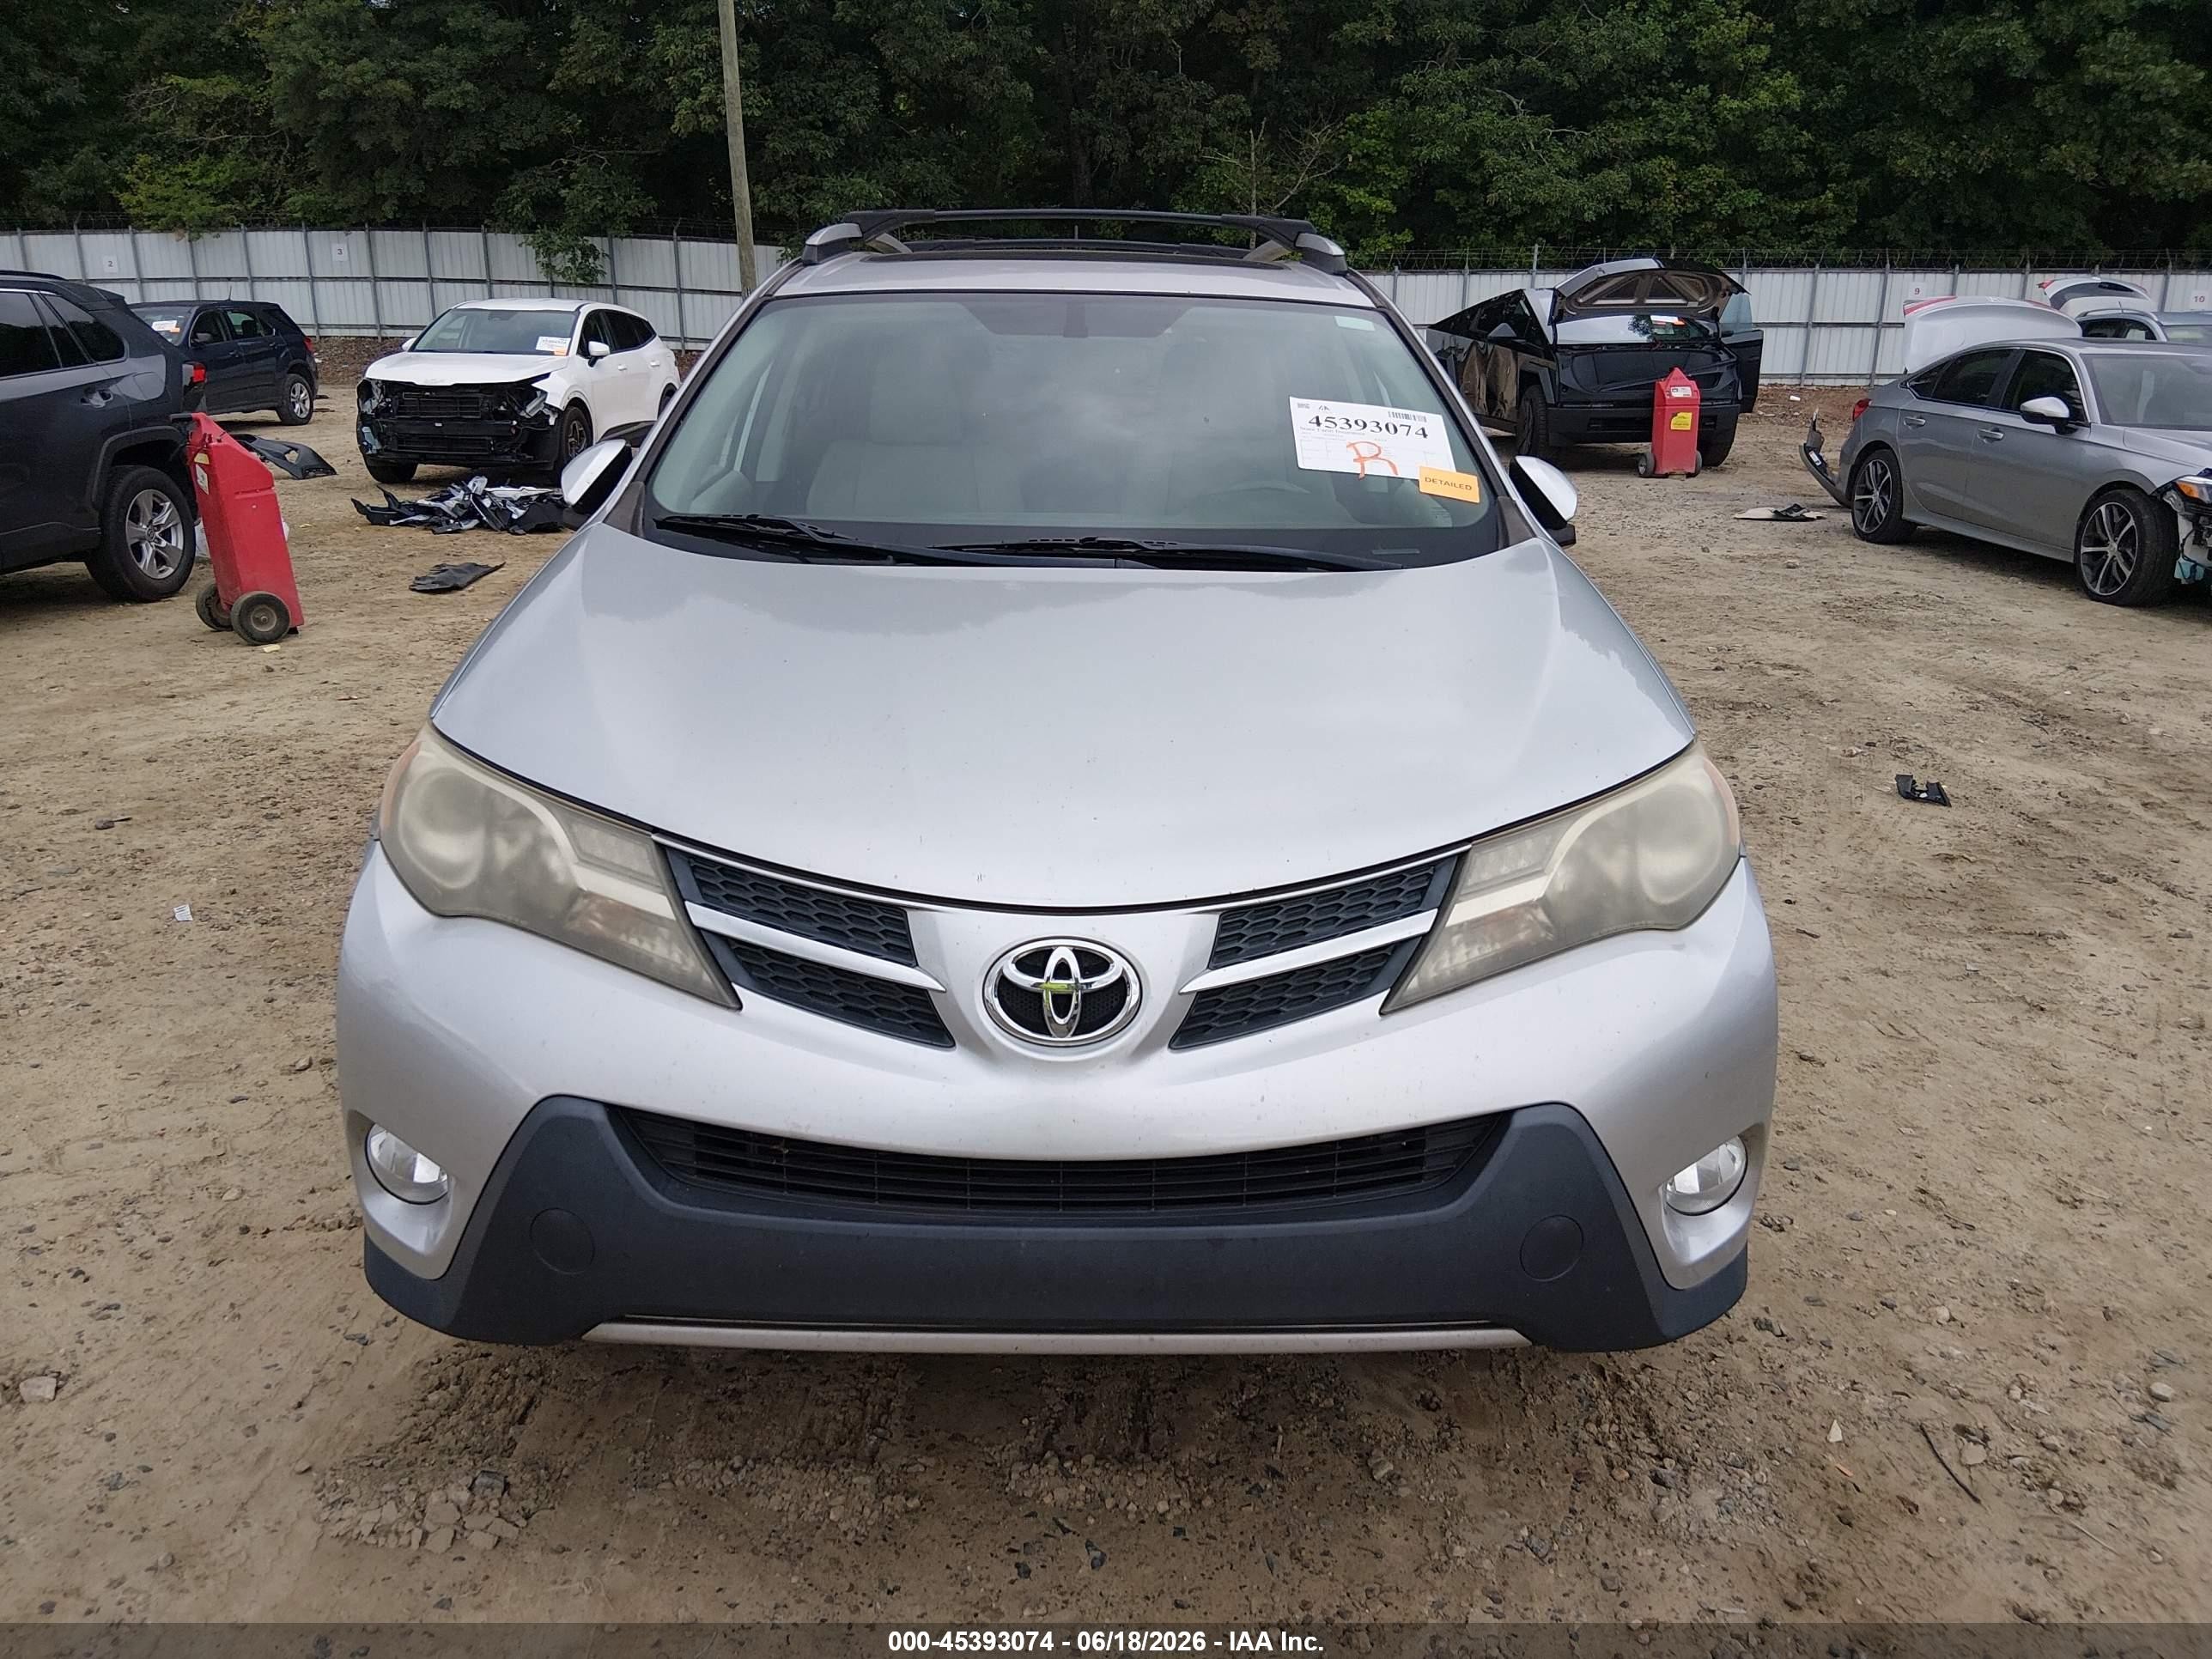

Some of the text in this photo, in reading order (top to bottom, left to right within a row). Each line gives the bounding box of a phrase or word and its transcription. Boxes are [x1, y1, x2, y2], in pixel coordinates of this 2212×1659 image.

[1308, 414, 1429, 440] 45393074
[1346, 441, 1400, 480] R
[1425, 476, 1473, 491] DETAILED
